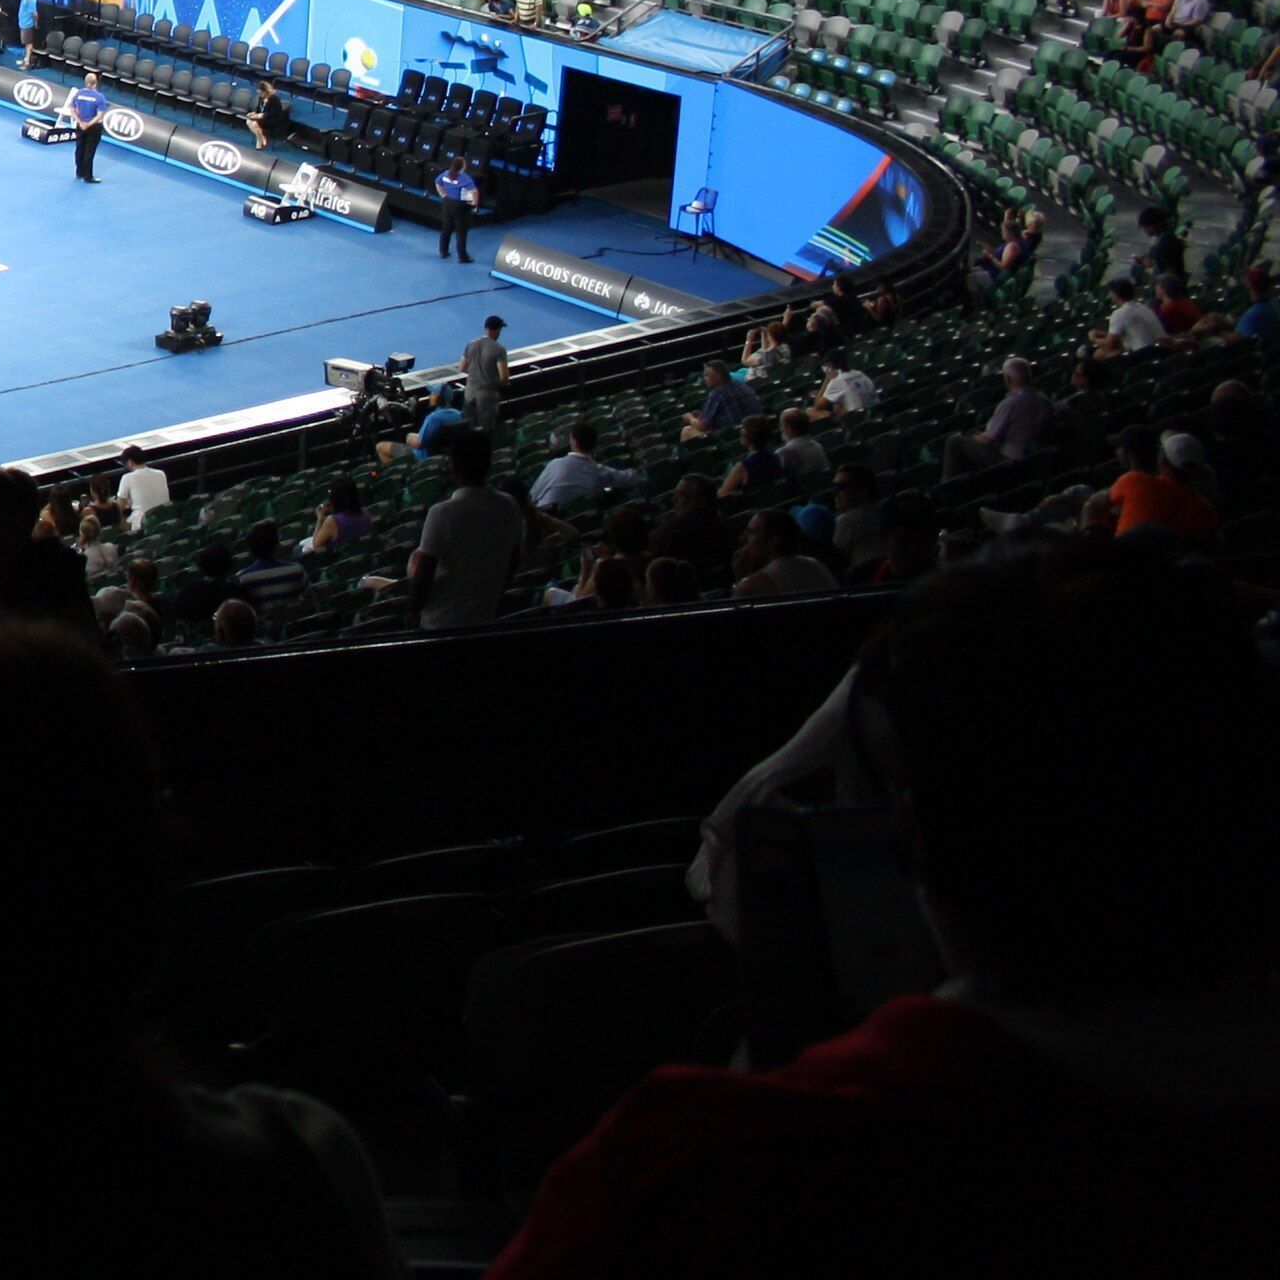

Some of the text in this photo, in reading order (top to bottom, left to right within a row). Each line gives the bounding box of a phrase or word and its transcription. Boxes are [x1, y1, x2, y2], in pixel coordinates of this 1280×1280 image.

[17, 83, 45, 105] KIA
[108, 113, 136, 137] KIA
[203, 145, 235, 169] KIA
[320, 176, 337, 192] Fly
[521, 257, 613, 299] JACOB'S CREEK
